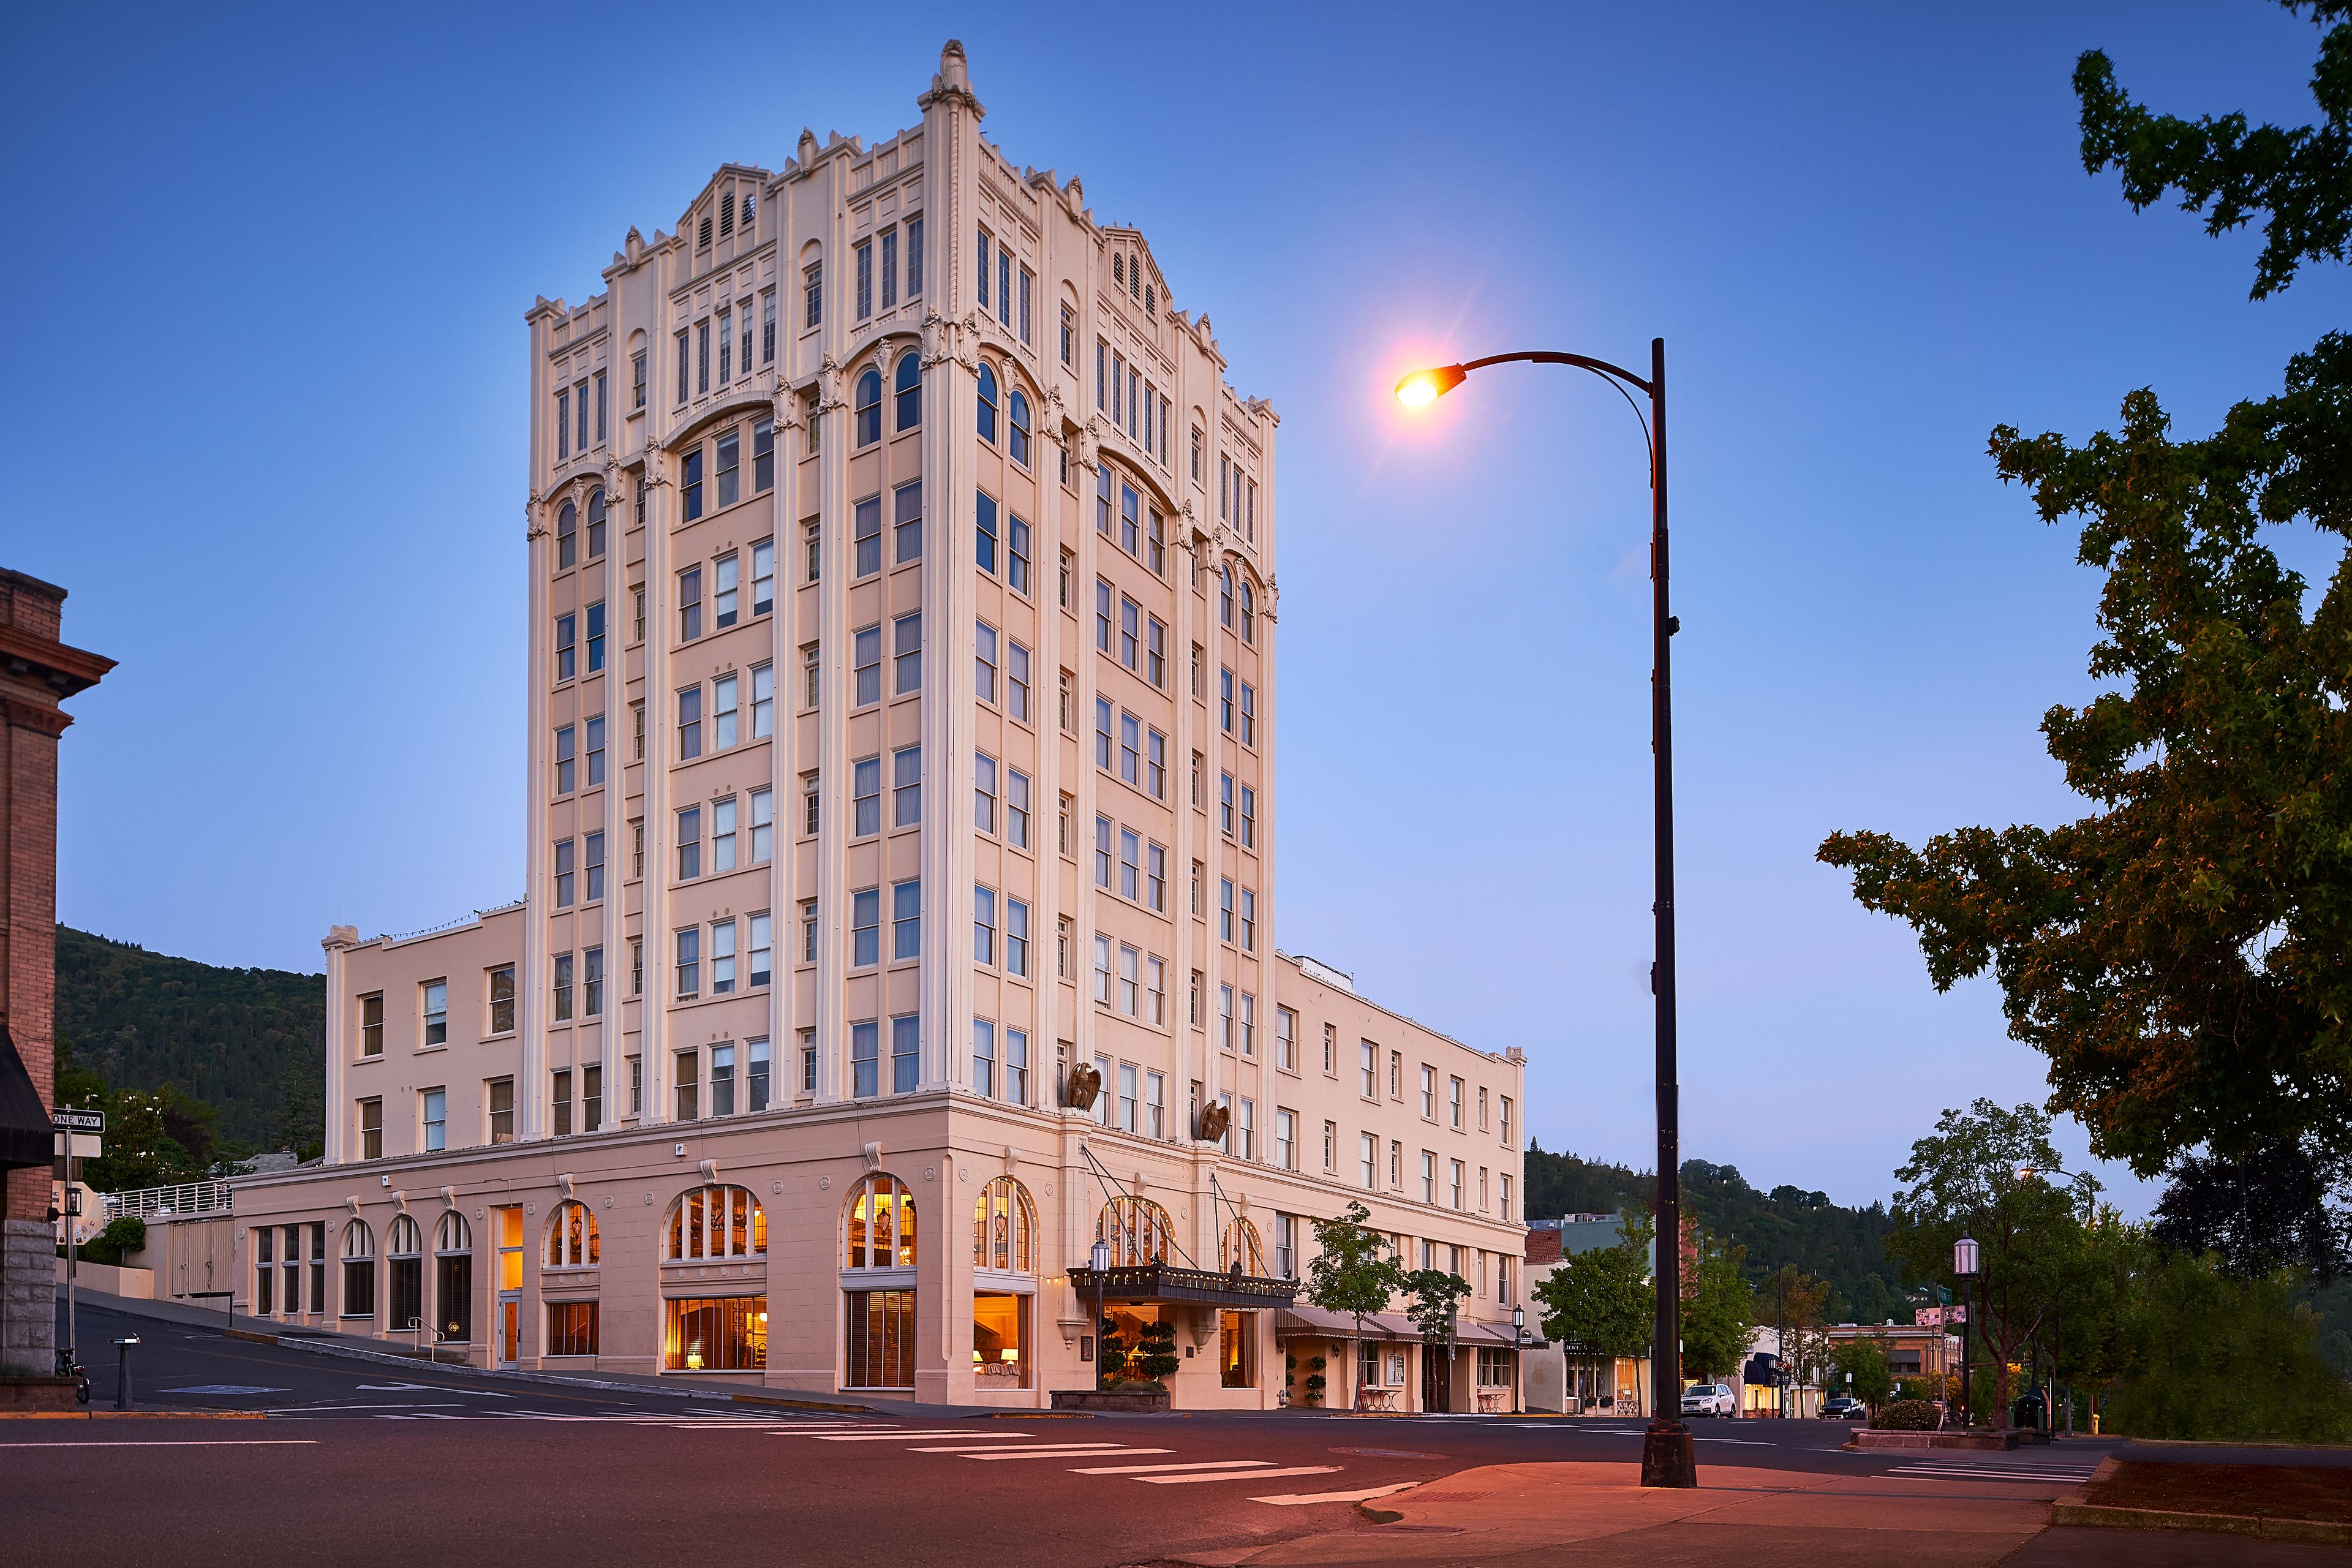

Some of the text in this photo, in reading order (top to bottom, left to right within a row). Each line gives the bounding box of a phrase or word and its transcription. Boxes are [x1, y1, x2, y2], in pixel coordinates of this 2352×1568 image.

[53, 1115, 97, 1126] ONE WAY
[1170, 1276, 1224, 1291] ASHLAND
